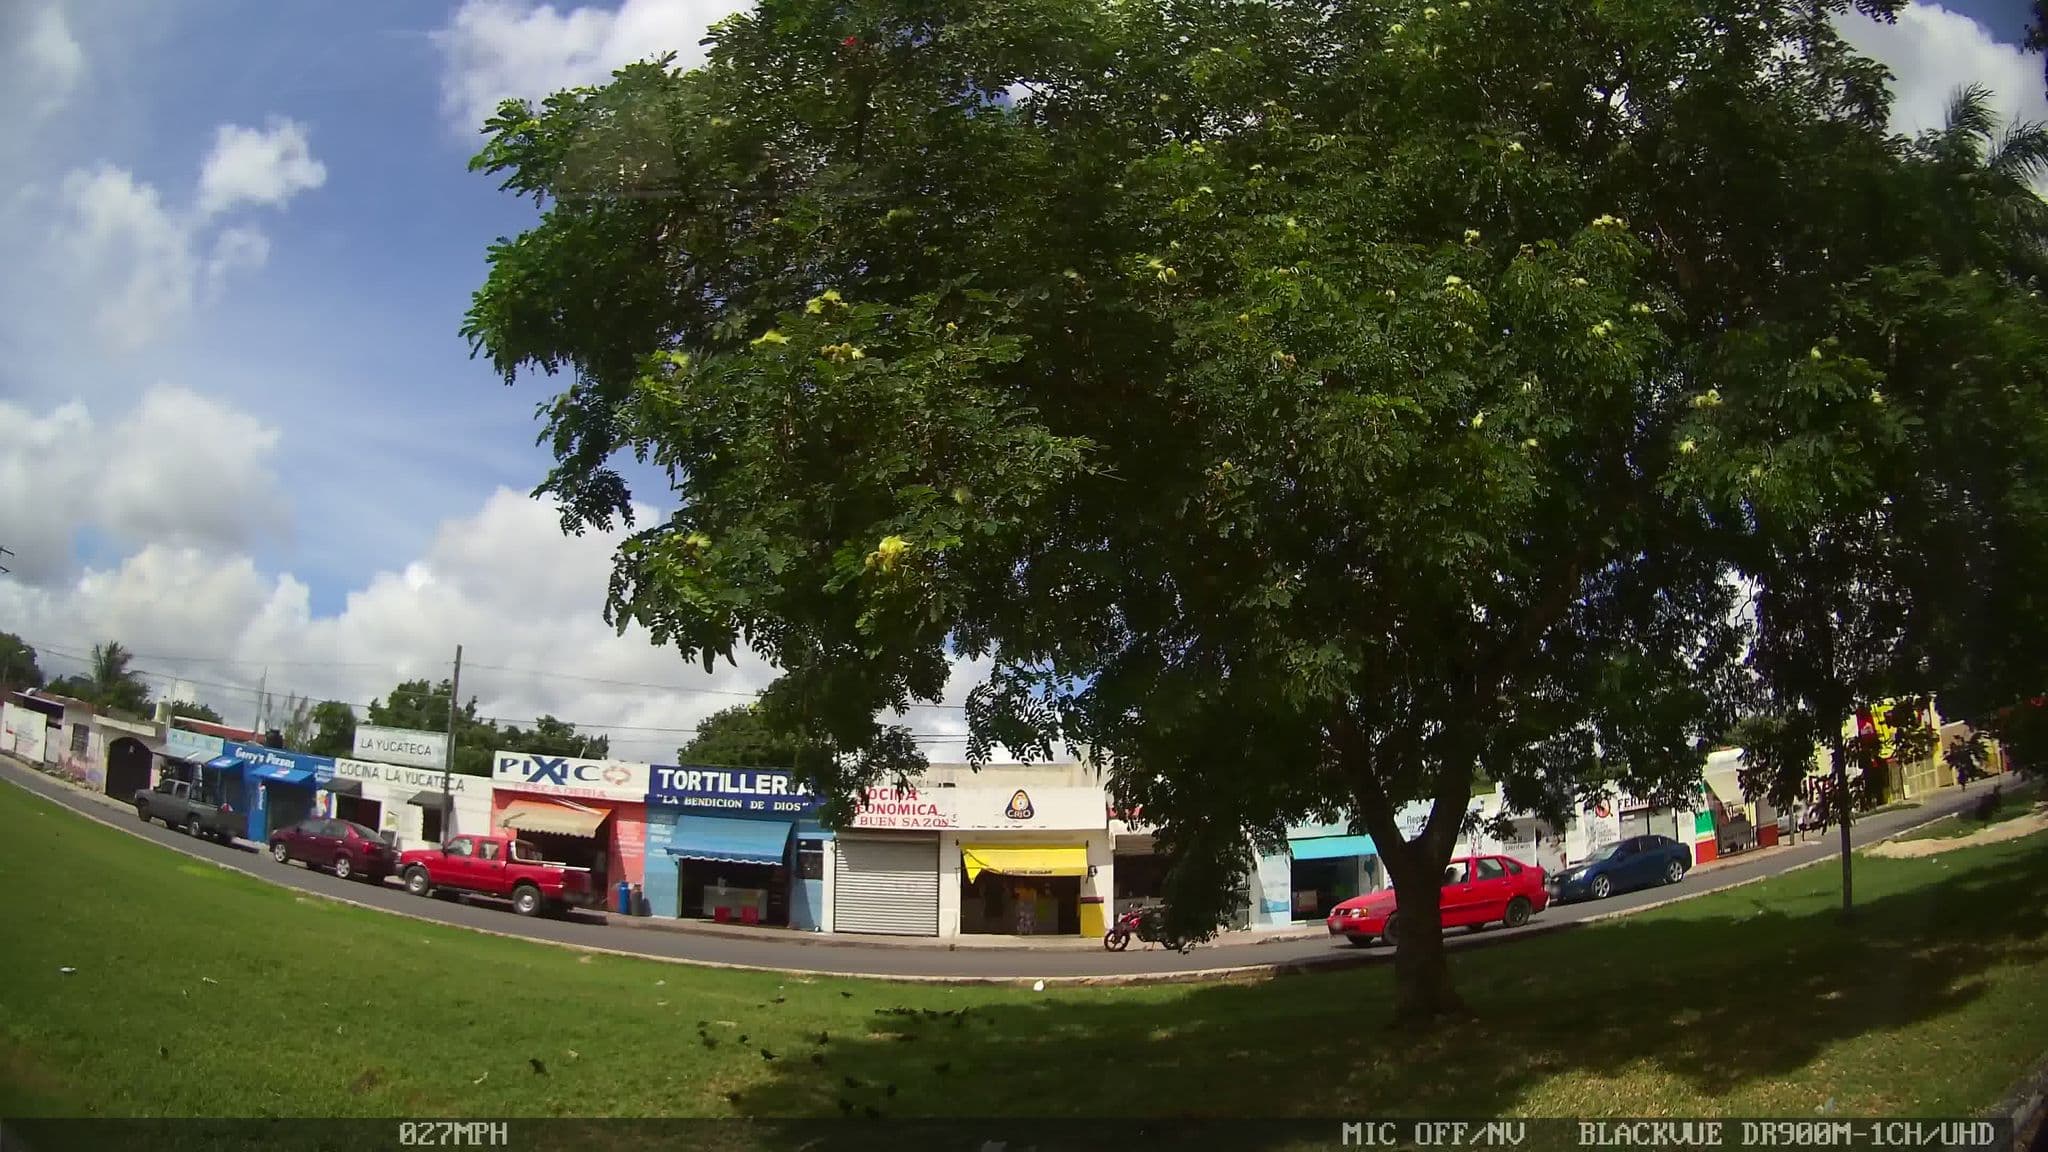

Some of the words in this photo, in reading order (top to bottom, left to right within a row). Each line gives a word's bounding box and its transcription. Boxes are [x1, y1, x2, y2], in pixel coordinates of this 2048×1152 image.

[360, 738, 374, 749] LA
[377, 740, 432, 755] YUCATECA
[340, 762, 380, 779] COCINA
[385, 770, 401, 782] LA
[405, 772, 465, 791] YUCATECA
[658, 769, 815, 797] TORTILLERA
[862, 787, 918, 801] OCINA
[684, 797, 742, 808] BENDICION
[750, 801, 764, 810] DE
[860, 816, 897, 826] BUEN
